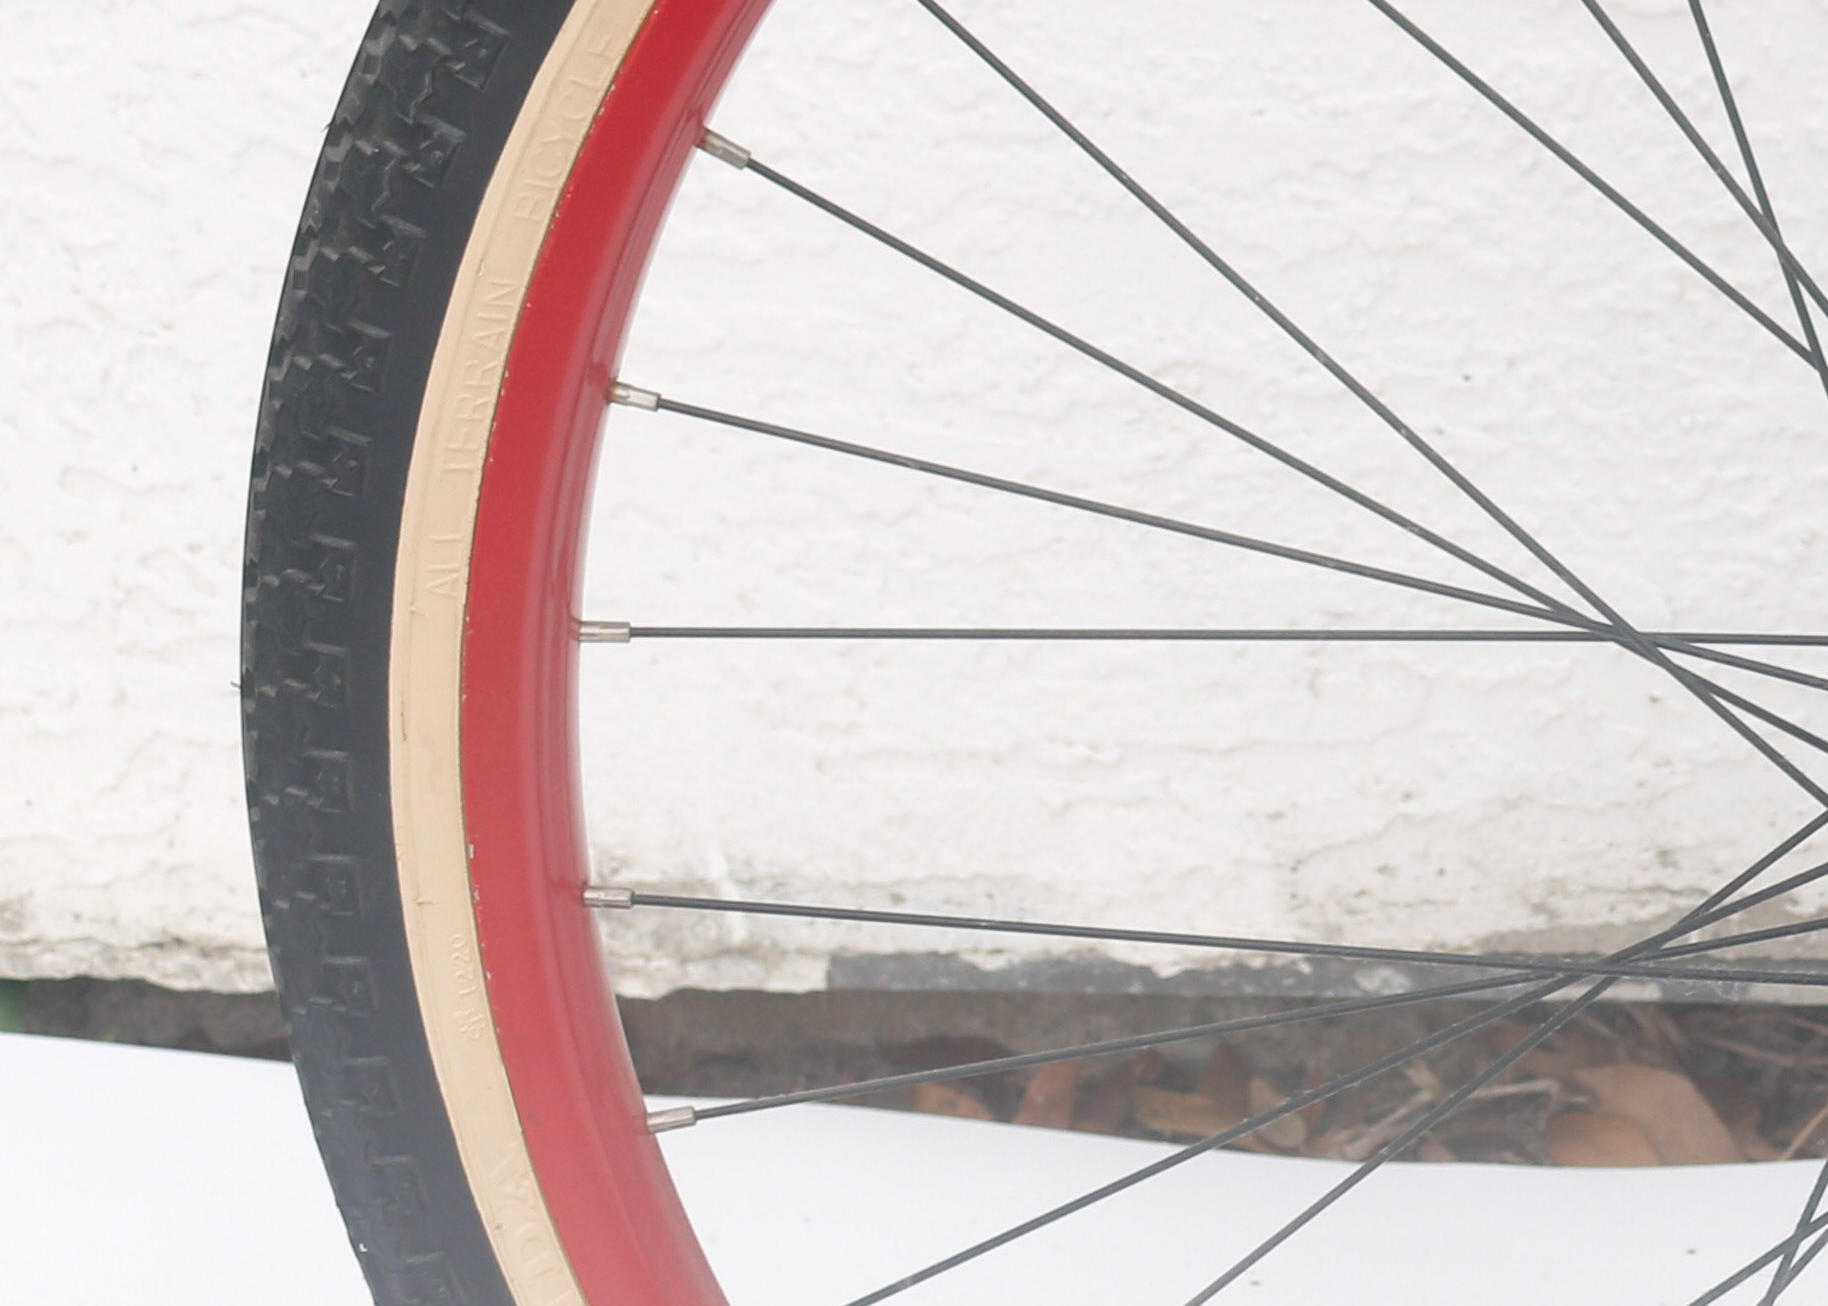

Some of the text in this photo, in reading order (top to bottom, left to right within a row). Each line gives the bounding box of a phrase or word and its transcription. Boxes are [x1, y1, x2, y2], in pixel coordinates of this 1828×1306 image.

[422, 26, 626, 599] ALL TERRAIN BICYCLE
[446, 930, 479, 999] 1220
